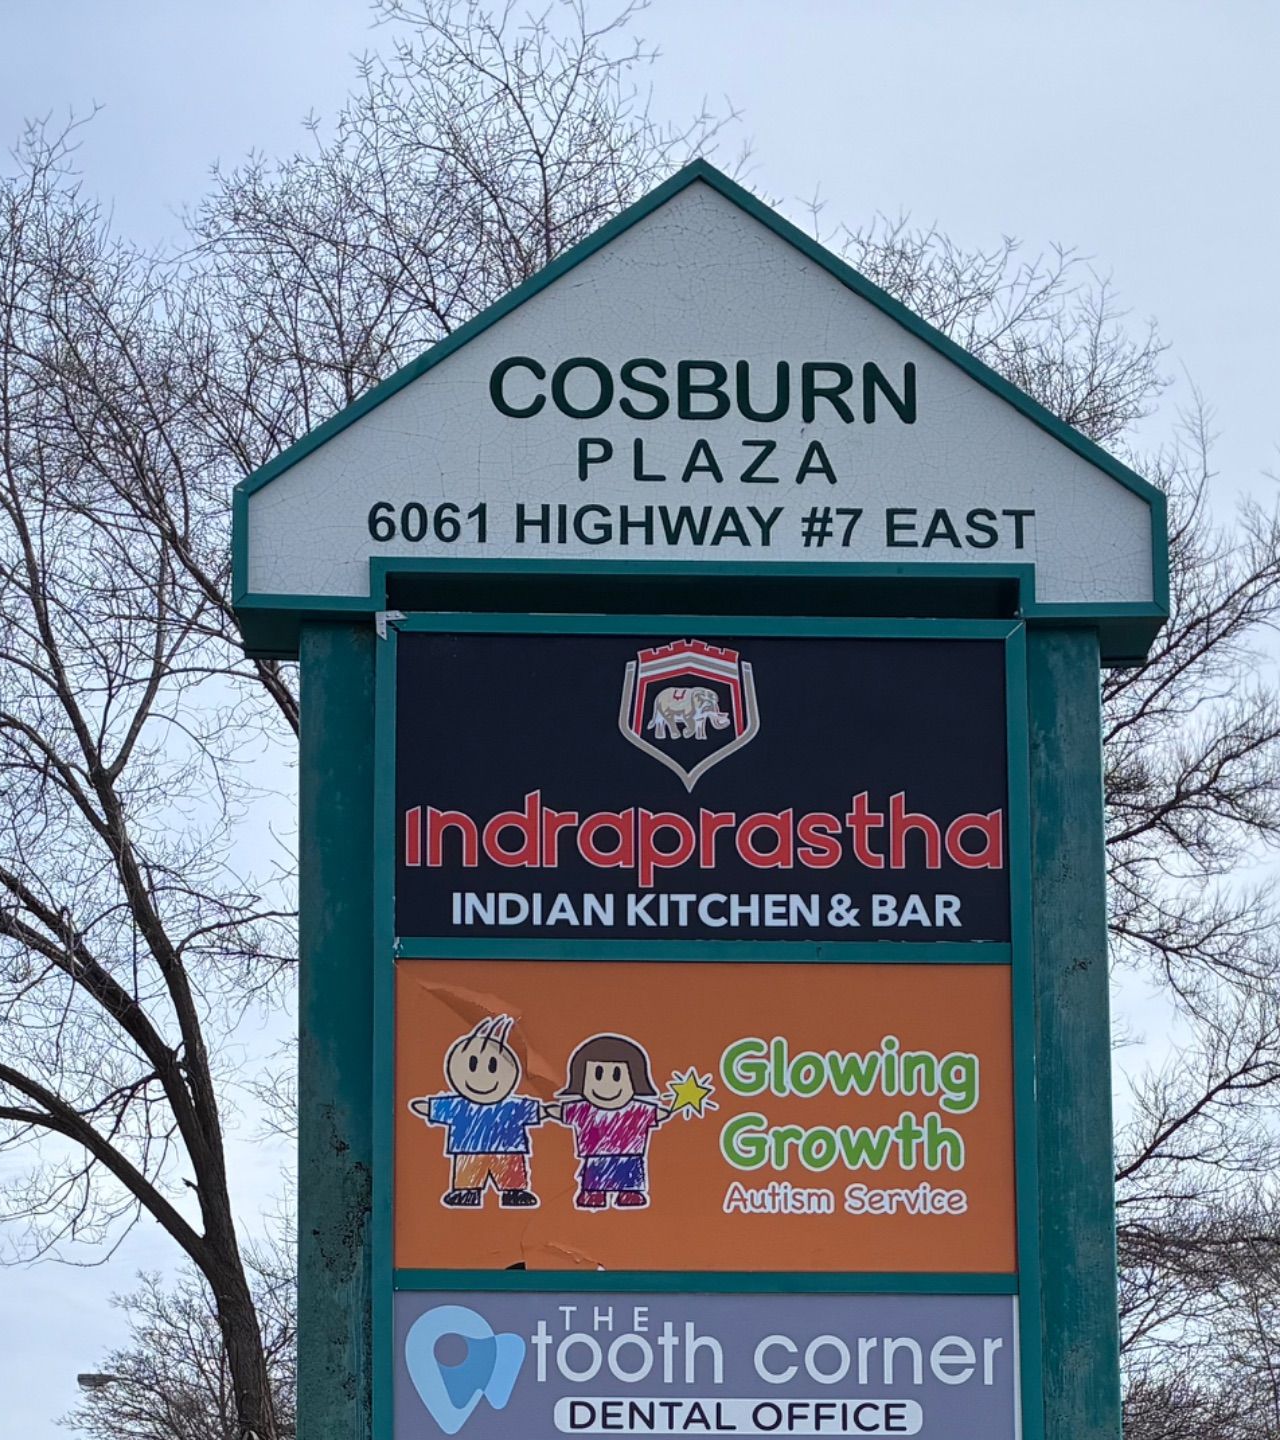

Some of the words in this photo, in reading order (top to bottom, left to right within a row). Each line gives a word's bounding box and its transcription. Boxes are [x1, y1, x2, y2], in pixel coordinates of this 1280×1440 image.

[489, 356, 917, 425] COSBURN
[577, 437, 838, 485] PLAZA
[367, 501, 487, 544] 6061
[515, 503, 785, 547] HIGHWAY
[801, 506, 864, 548] #7
[885, 507, 1036, 550] EAST
[452, 892, 614, 926] INDIAN
[626, 893, 819, 927] KITCHEN
[827, 894, 860, 928] &
[871, 893, 962, 927] BAR
[719, 1035, 980, 1112] Glowing
[719, 1112, 964, 1172] Growth
[722, 1181, 835, 1215] Autism
[844, 1181, 968, 1215] Service
[559, 1306, 649, 1332] THE
[530, 1319, 724, 1384] tooth
[753, 1334, 1003, 1386] corner
[569, 1401, 737, 1431] DENTAL
[751, 1402, 908, 1432] OFFICE
